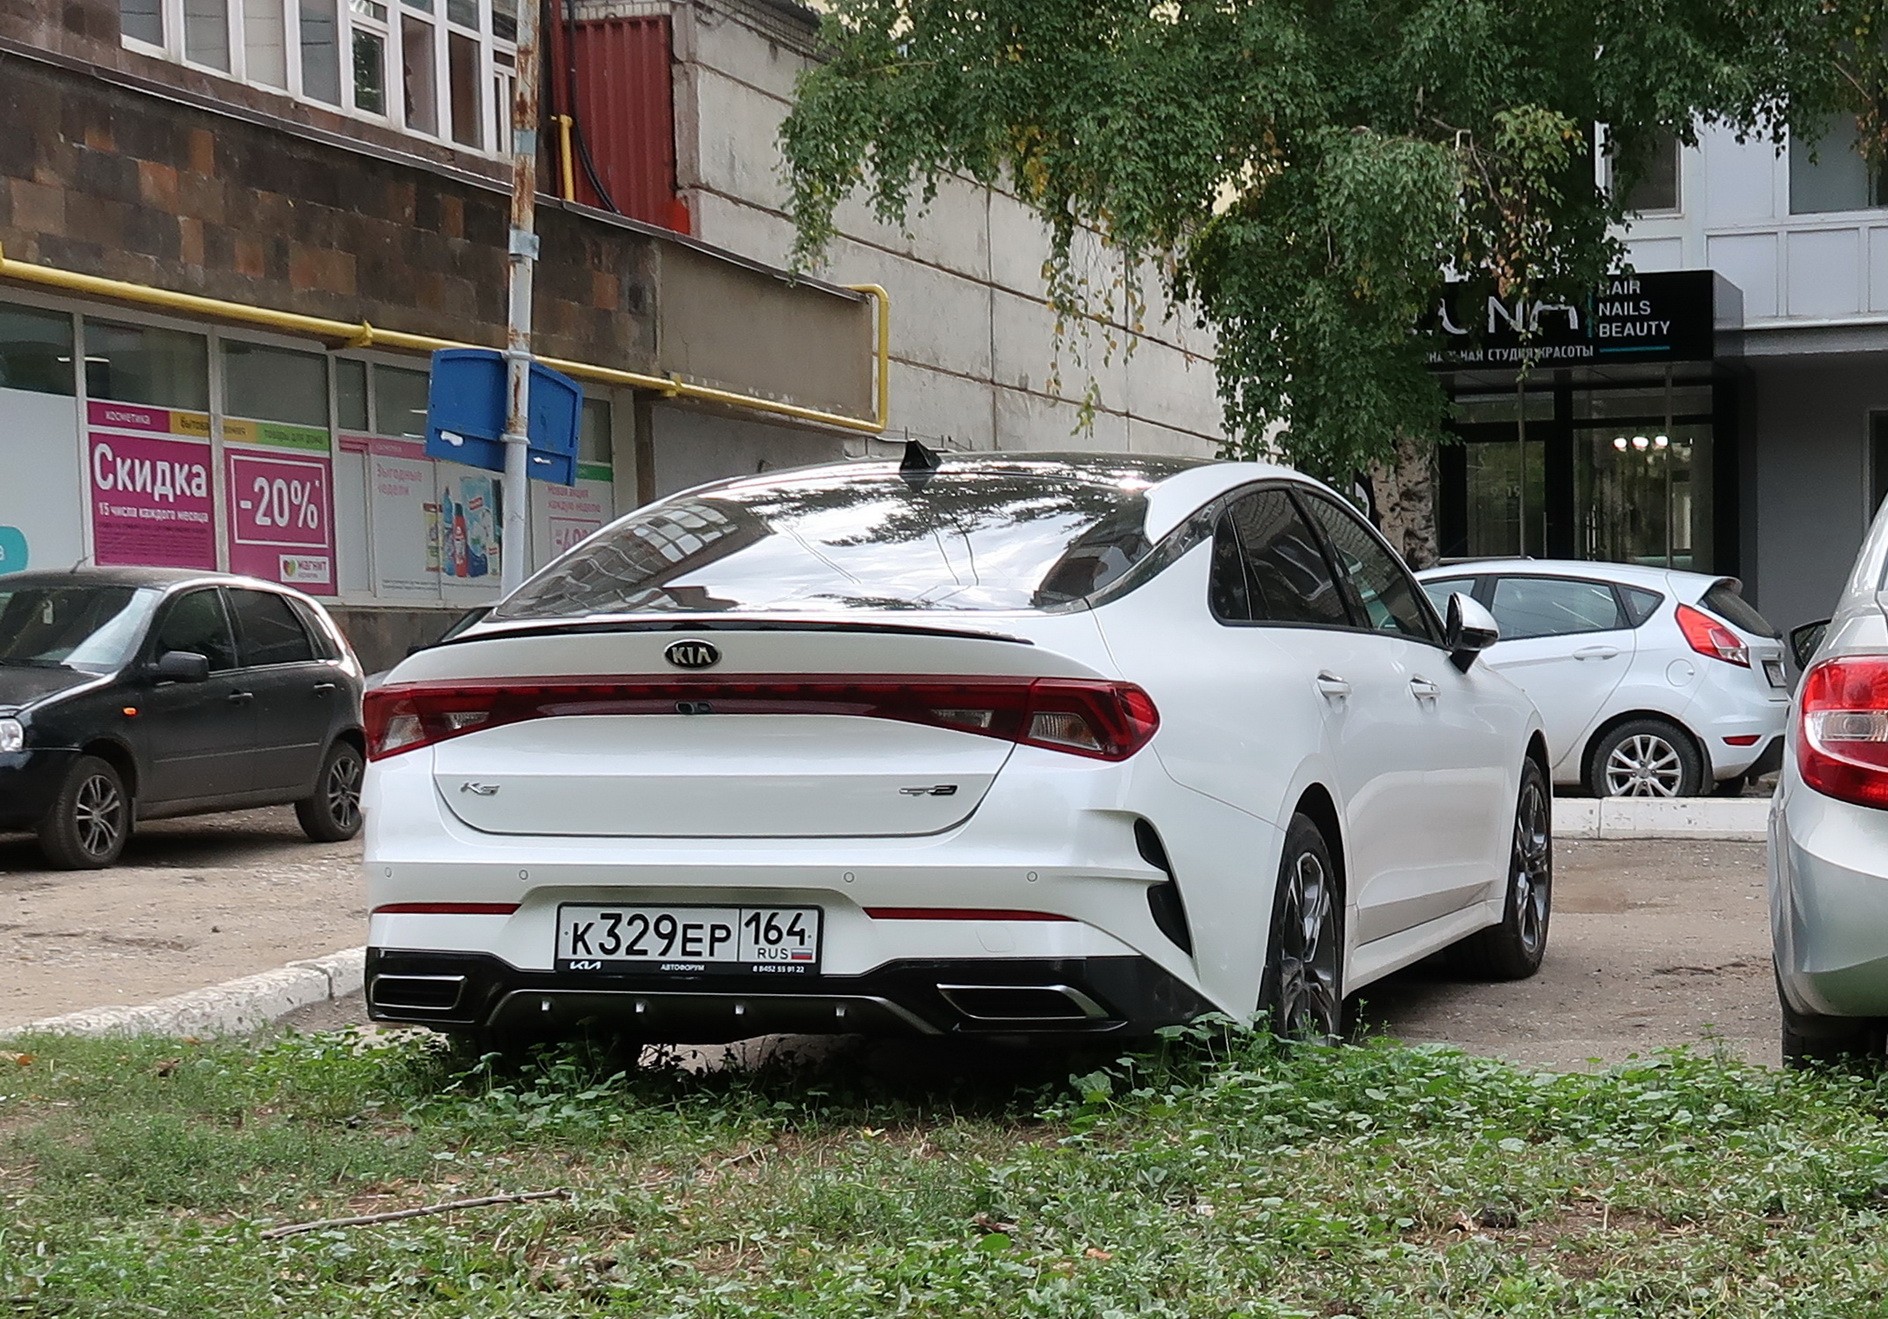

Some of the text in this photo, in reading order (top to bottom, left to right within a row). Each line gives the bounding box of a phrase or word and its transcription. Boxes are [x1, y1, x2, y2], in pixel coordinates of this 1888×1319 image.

[1598, 300, 1651, 316] NAILS
[1598, 321, 1671, 338] BEAUTY
[1488, 348, 1533, 362] СТУДИЯ
[1536, 346, 1593, 359] КРАСОТЫ
[104, 410, 151, 425] косметика
[93, 443, 208, 503] Скидка
[98, 502, 209, 523] 15 числа каждого месяца
[671, 646, 713, 665] KIA
[743, 911, 806, 947] 164
[757, 947, 789, 960] RUS
[660, 963, 705, 972] АВТОФОРУМ
